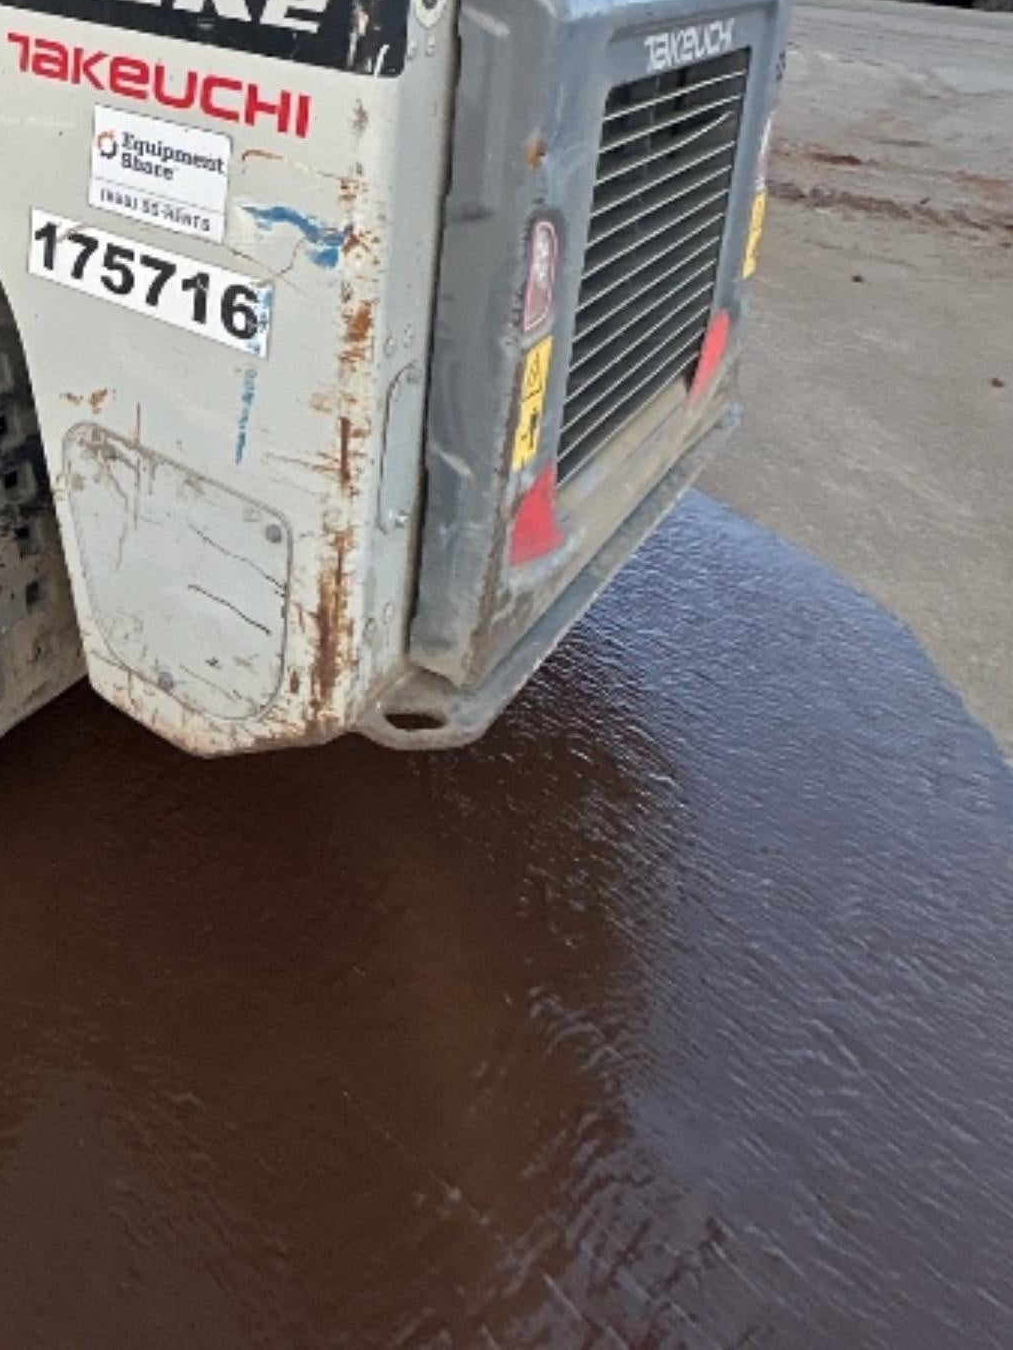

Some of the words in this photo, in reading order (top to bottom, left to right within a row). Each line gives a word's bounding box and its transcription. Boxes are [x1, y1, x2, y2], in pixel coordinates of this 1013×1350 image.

[121, 131, 225, 175] Equipment
[121, 152, 174, 180] Share
[34, 221, 259, 340] 175716
